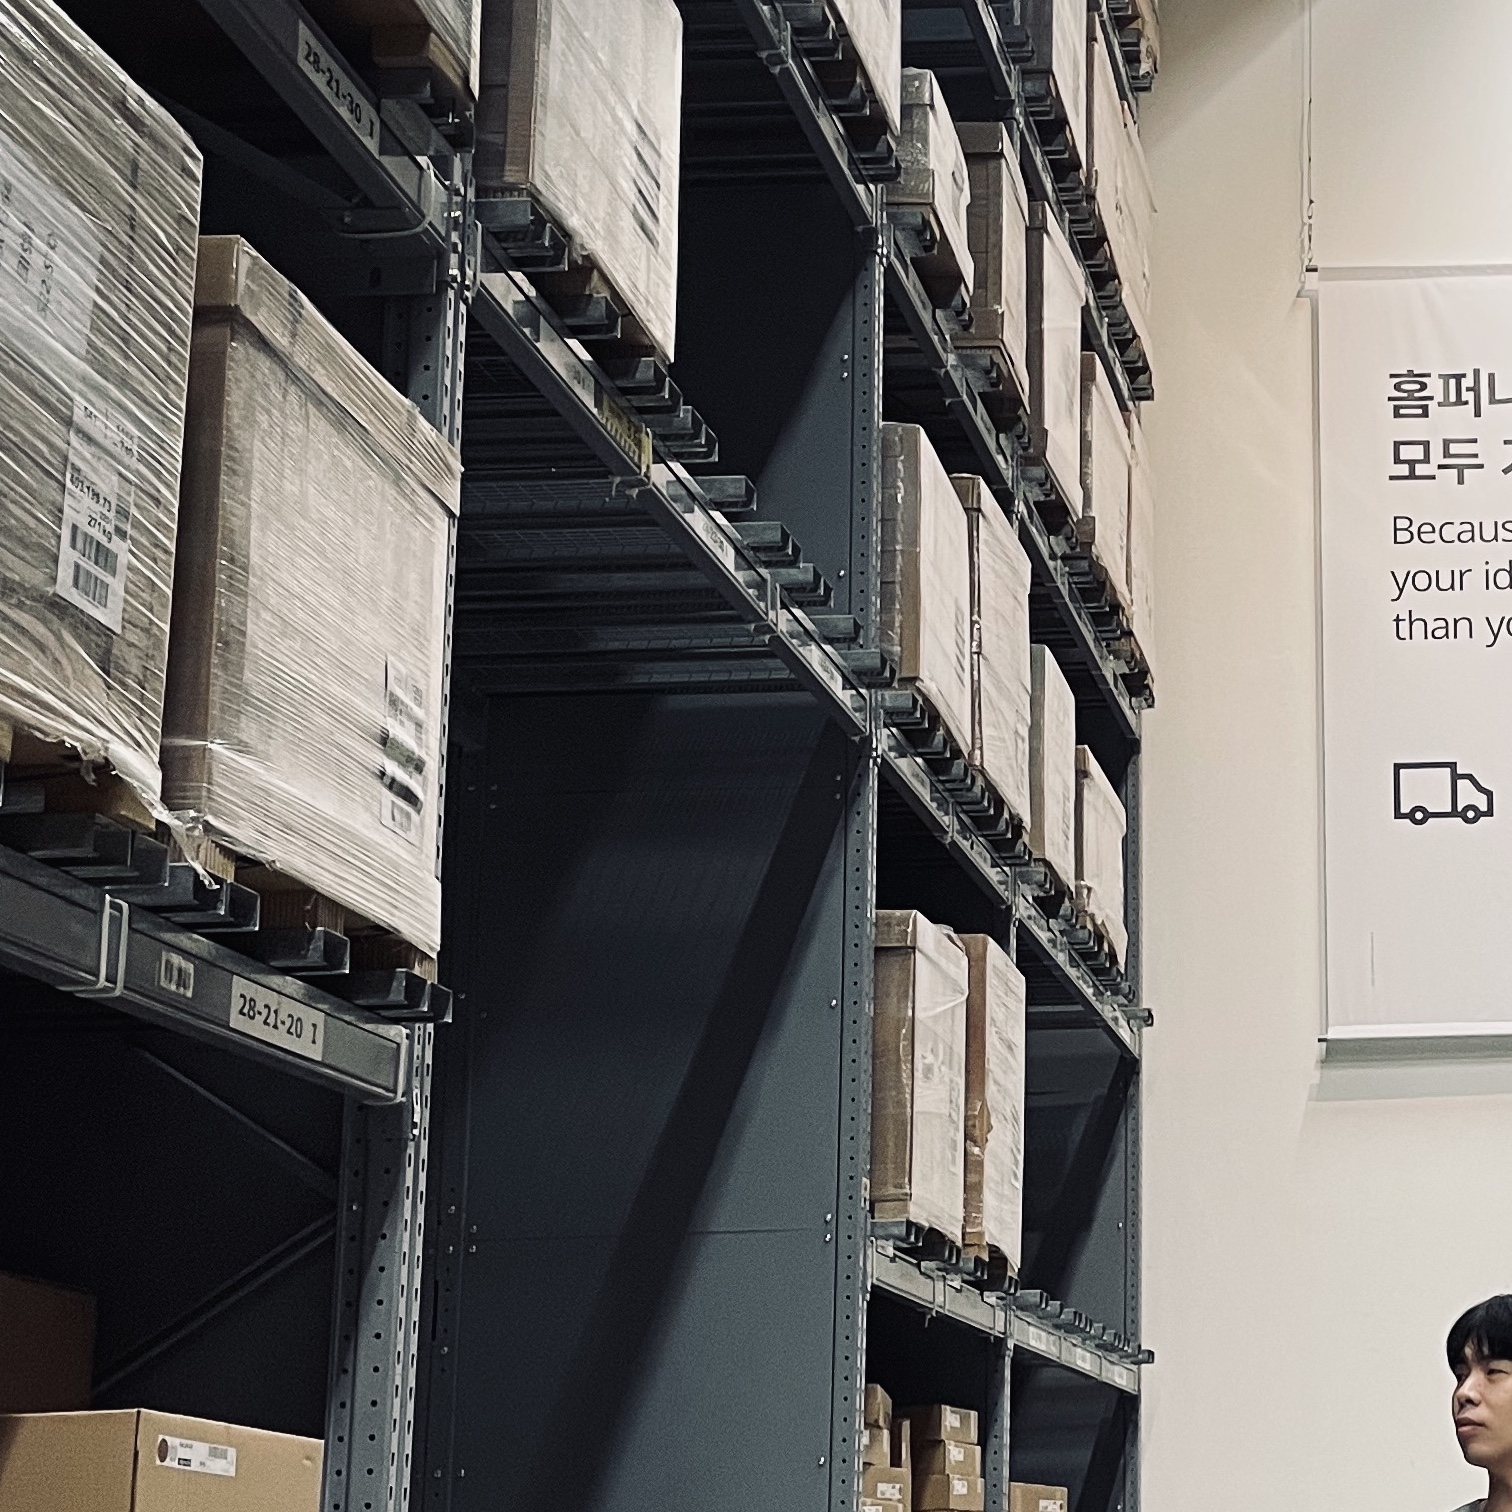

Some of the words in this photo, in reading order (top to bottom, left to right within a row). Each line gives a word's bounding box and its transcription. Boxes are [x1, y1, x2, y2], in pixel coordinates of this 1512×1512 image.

[1388, 438, 1485, 486] 모두
[1390, 568, 1472, 603] your
[1392, 609, 1474, 641] than
[238, 992, 304, 1040] 28-21-20
[311, 1022, 318, 1045] 1
